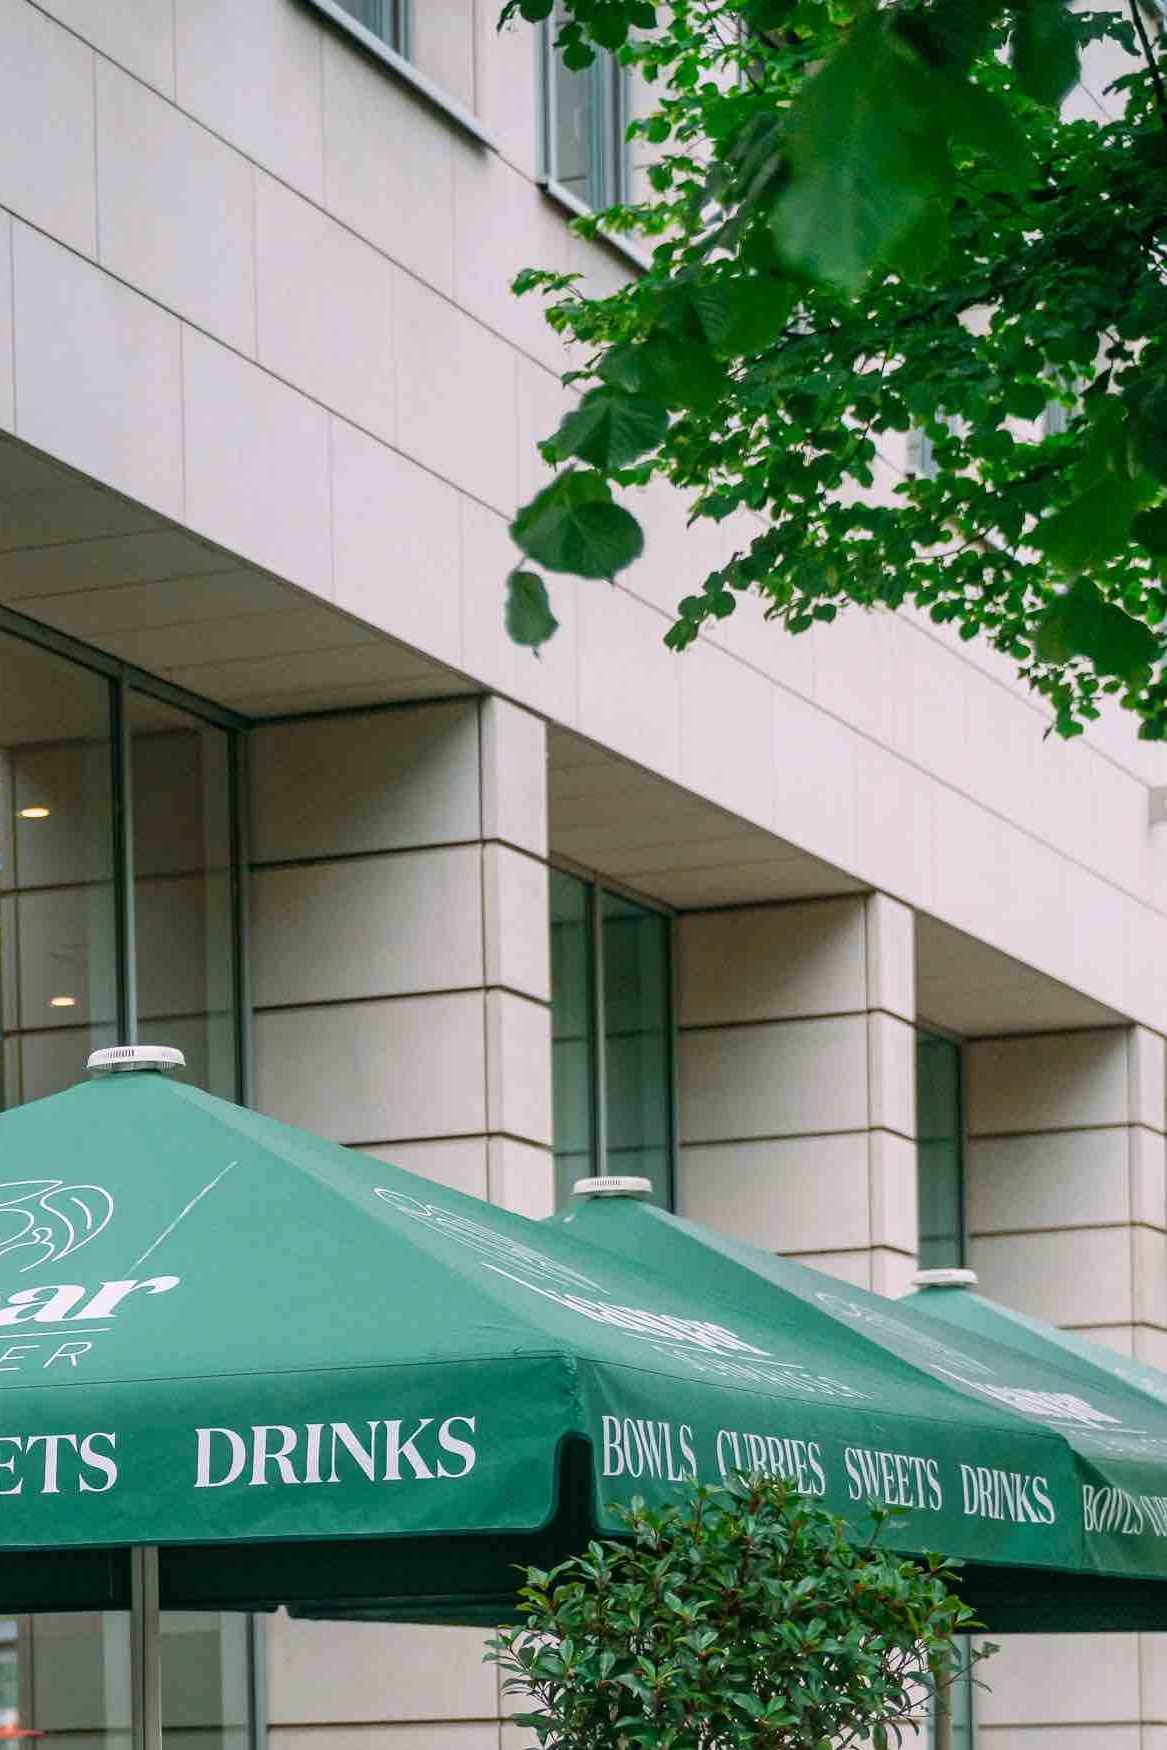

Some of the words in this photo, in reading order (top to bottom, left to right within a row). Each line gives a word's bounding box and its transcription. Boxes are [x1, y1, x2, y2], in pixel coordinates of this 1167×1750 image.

[195, 1416, 478, 1488] DRINKS
[602, 1416, 697, 1481] BOWLS
[844, 1447, 942, 1511] SWEETS
[959, 1464, 1056, 1524] DRINKS
